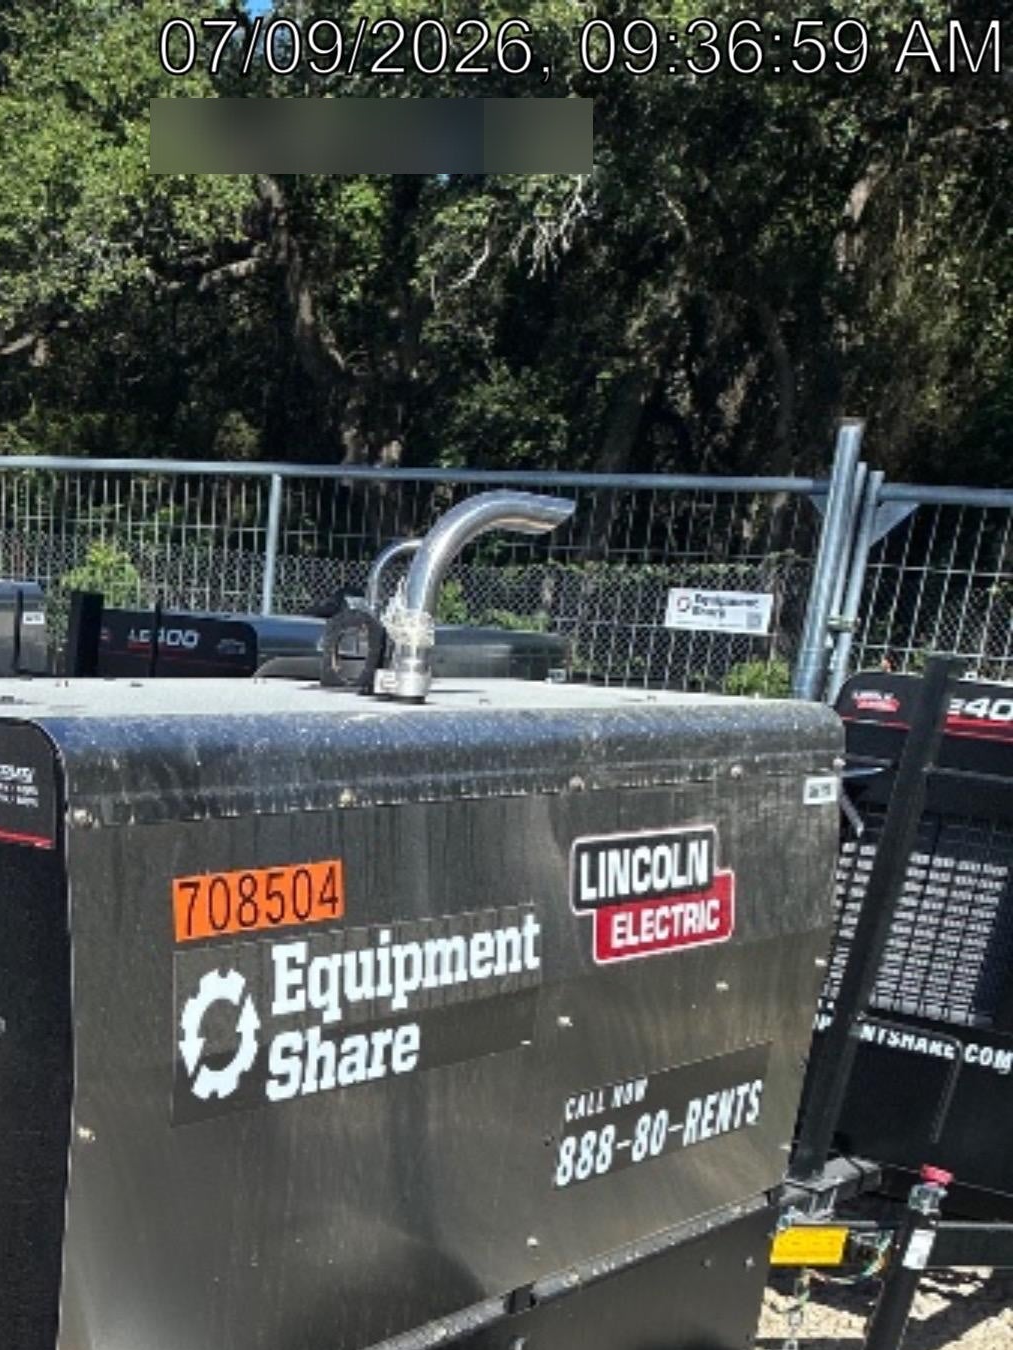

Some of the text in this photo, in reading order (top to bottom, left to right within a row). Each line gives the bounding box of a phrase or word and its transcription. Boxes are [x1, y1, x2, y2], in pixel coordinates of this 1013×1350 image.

[178, 866, 339, 937] 708504
[580, 839, 709, 901] LINCOLN
[610, 899, 721, 950] ELECTRIC
[271, 913, 541, 1024] Equipment
[265, 1022, 421, 1102] Share
[555, 1078, 763, 1187] 888-80-RENTS
[564, 1077, 649, 1122] CALL NOW
